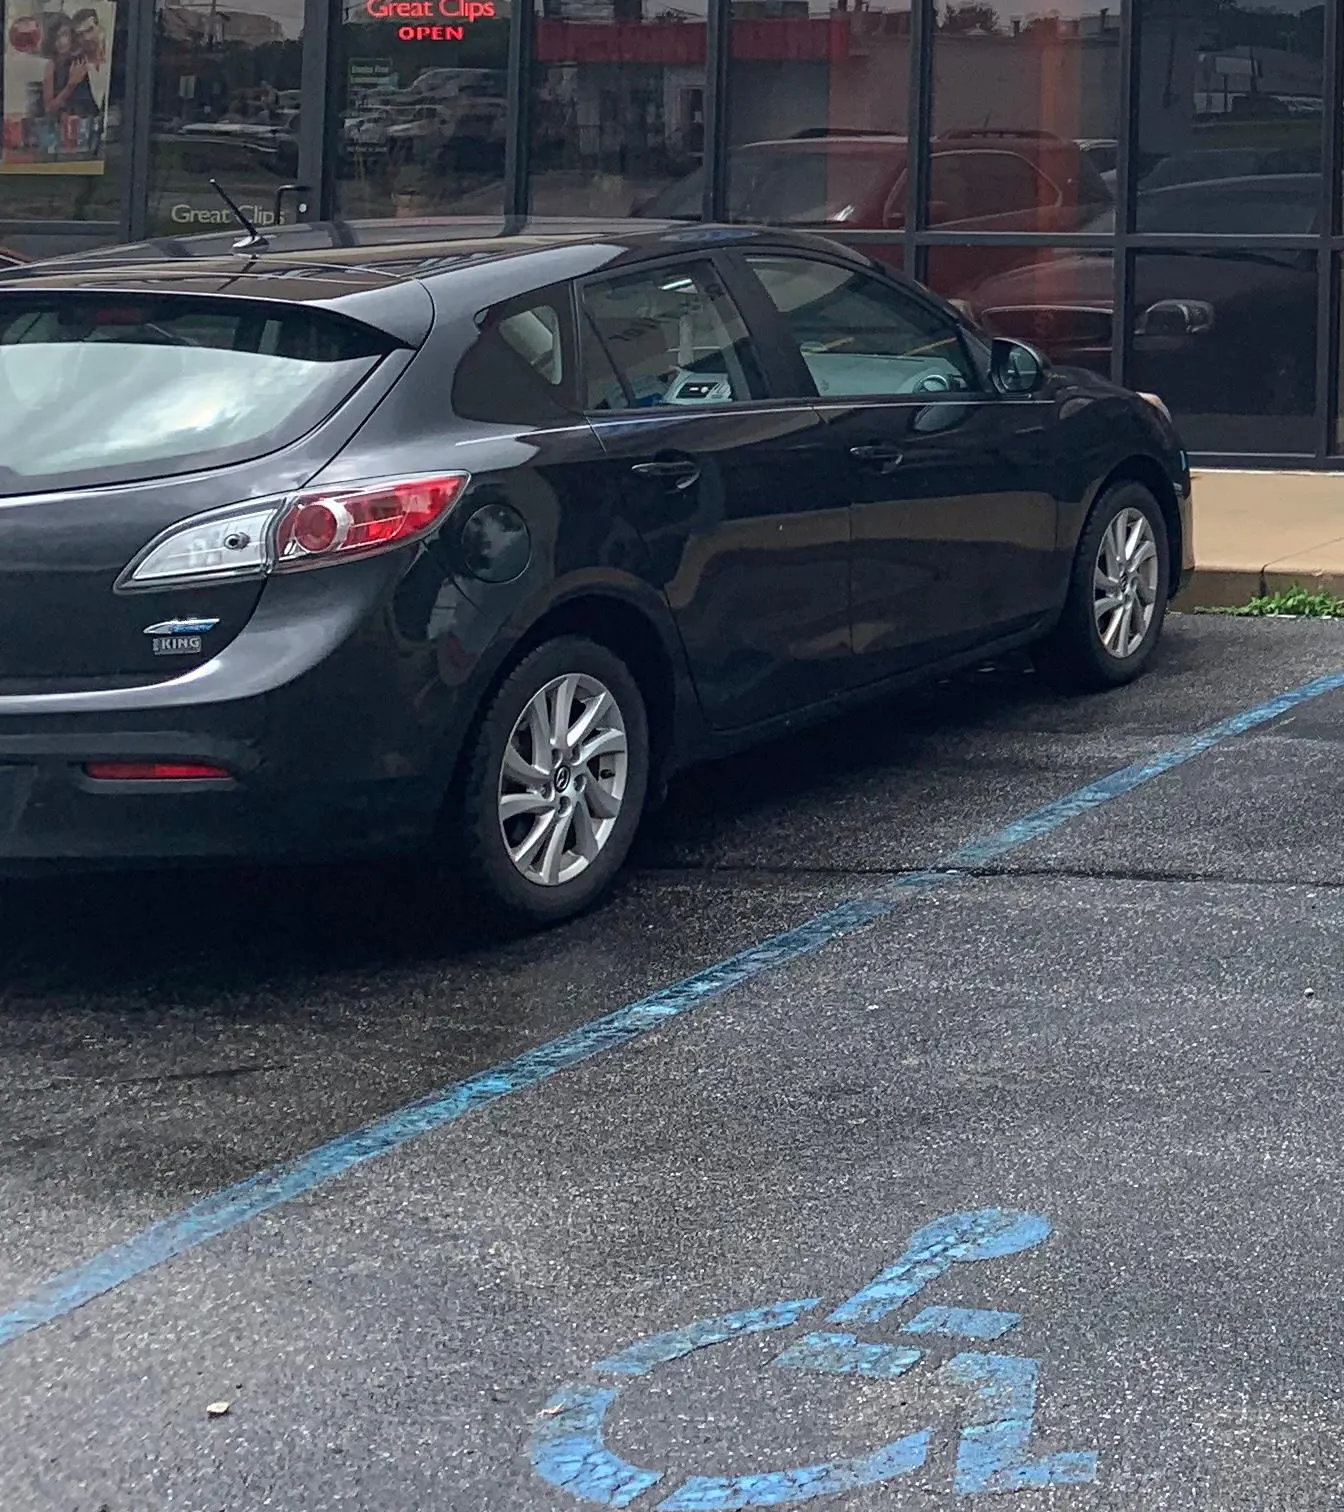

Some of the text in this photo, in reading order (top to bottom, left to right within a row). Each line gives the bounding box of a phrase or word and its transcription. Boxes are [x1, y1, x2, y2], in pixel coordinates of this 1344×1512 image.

[398, 26, 464, 41] OPEN
[171, 204, 231, 224] Great
[161, 637, 200, 650] KING
